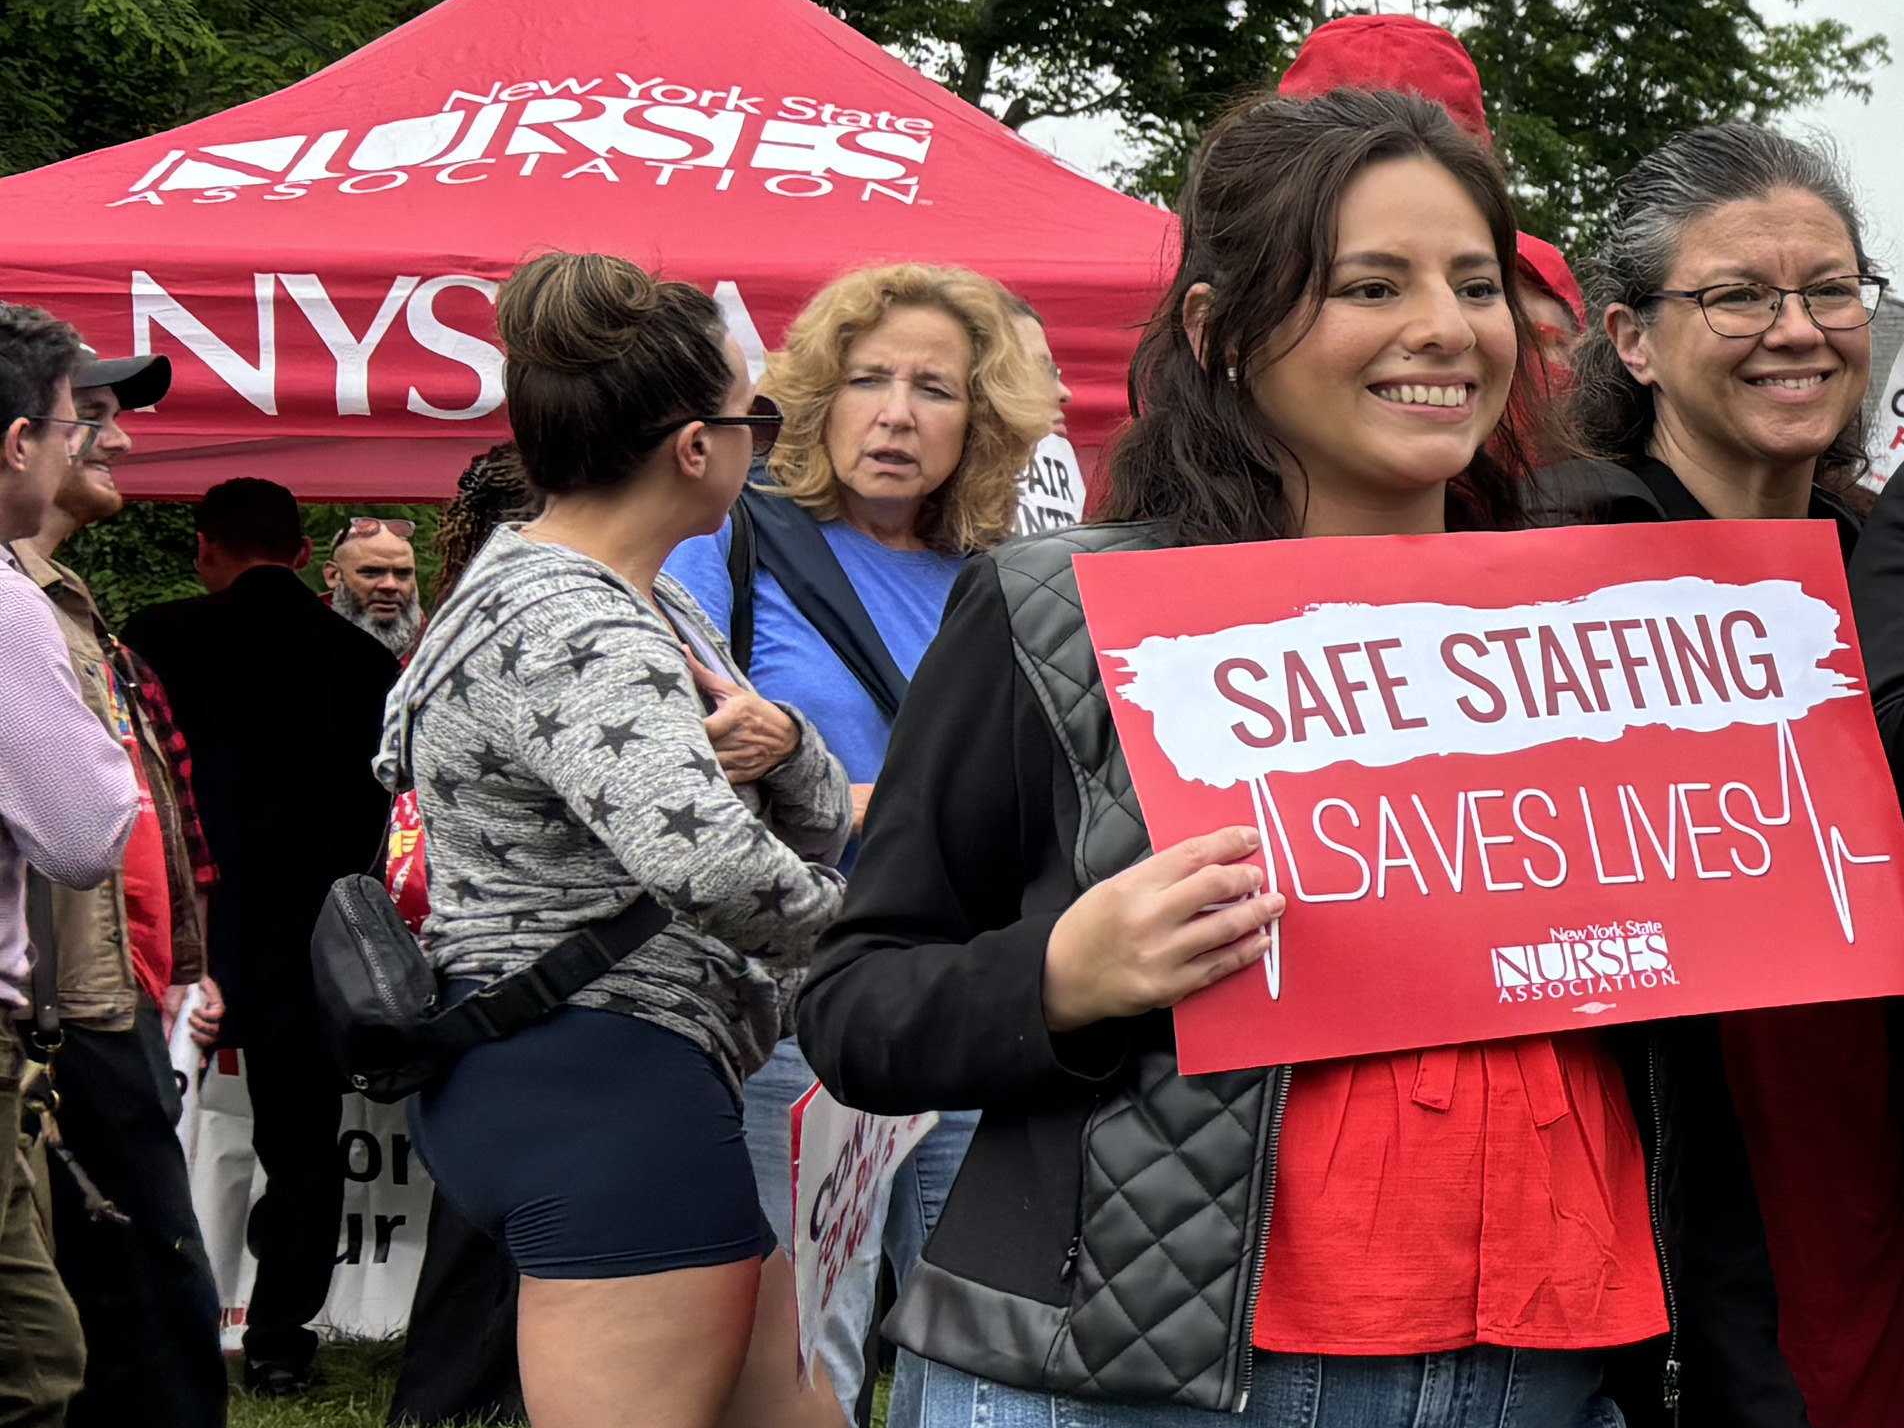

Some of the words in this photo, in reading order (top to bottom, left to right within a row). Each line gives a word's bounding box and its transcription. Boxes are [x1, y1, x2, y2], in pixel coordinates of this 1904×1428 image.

[444, 77, 603, 111] New
[615, 73, 764, 114] York
[776, 95, 935, 135] State
[129, 96, 932, 192] NURSES
[105, 153, 920, 207] ASSOCIATION
[1213, 638, 1428, 748] SAFE
[1440, 610, 1784, 723] STAFFING
[1300, 786, 1568, 903] SAVES
[1580, 781, 1772, 885] LIVES
[1550, 927, 1586, 943] New
[1587, 921, 1624, 939] York
[1625, 920, 1662, 936] State
[1491, 935, 1669, 987] NURSES
[1499, 968, 1676, 1003] ASSOCIATION
